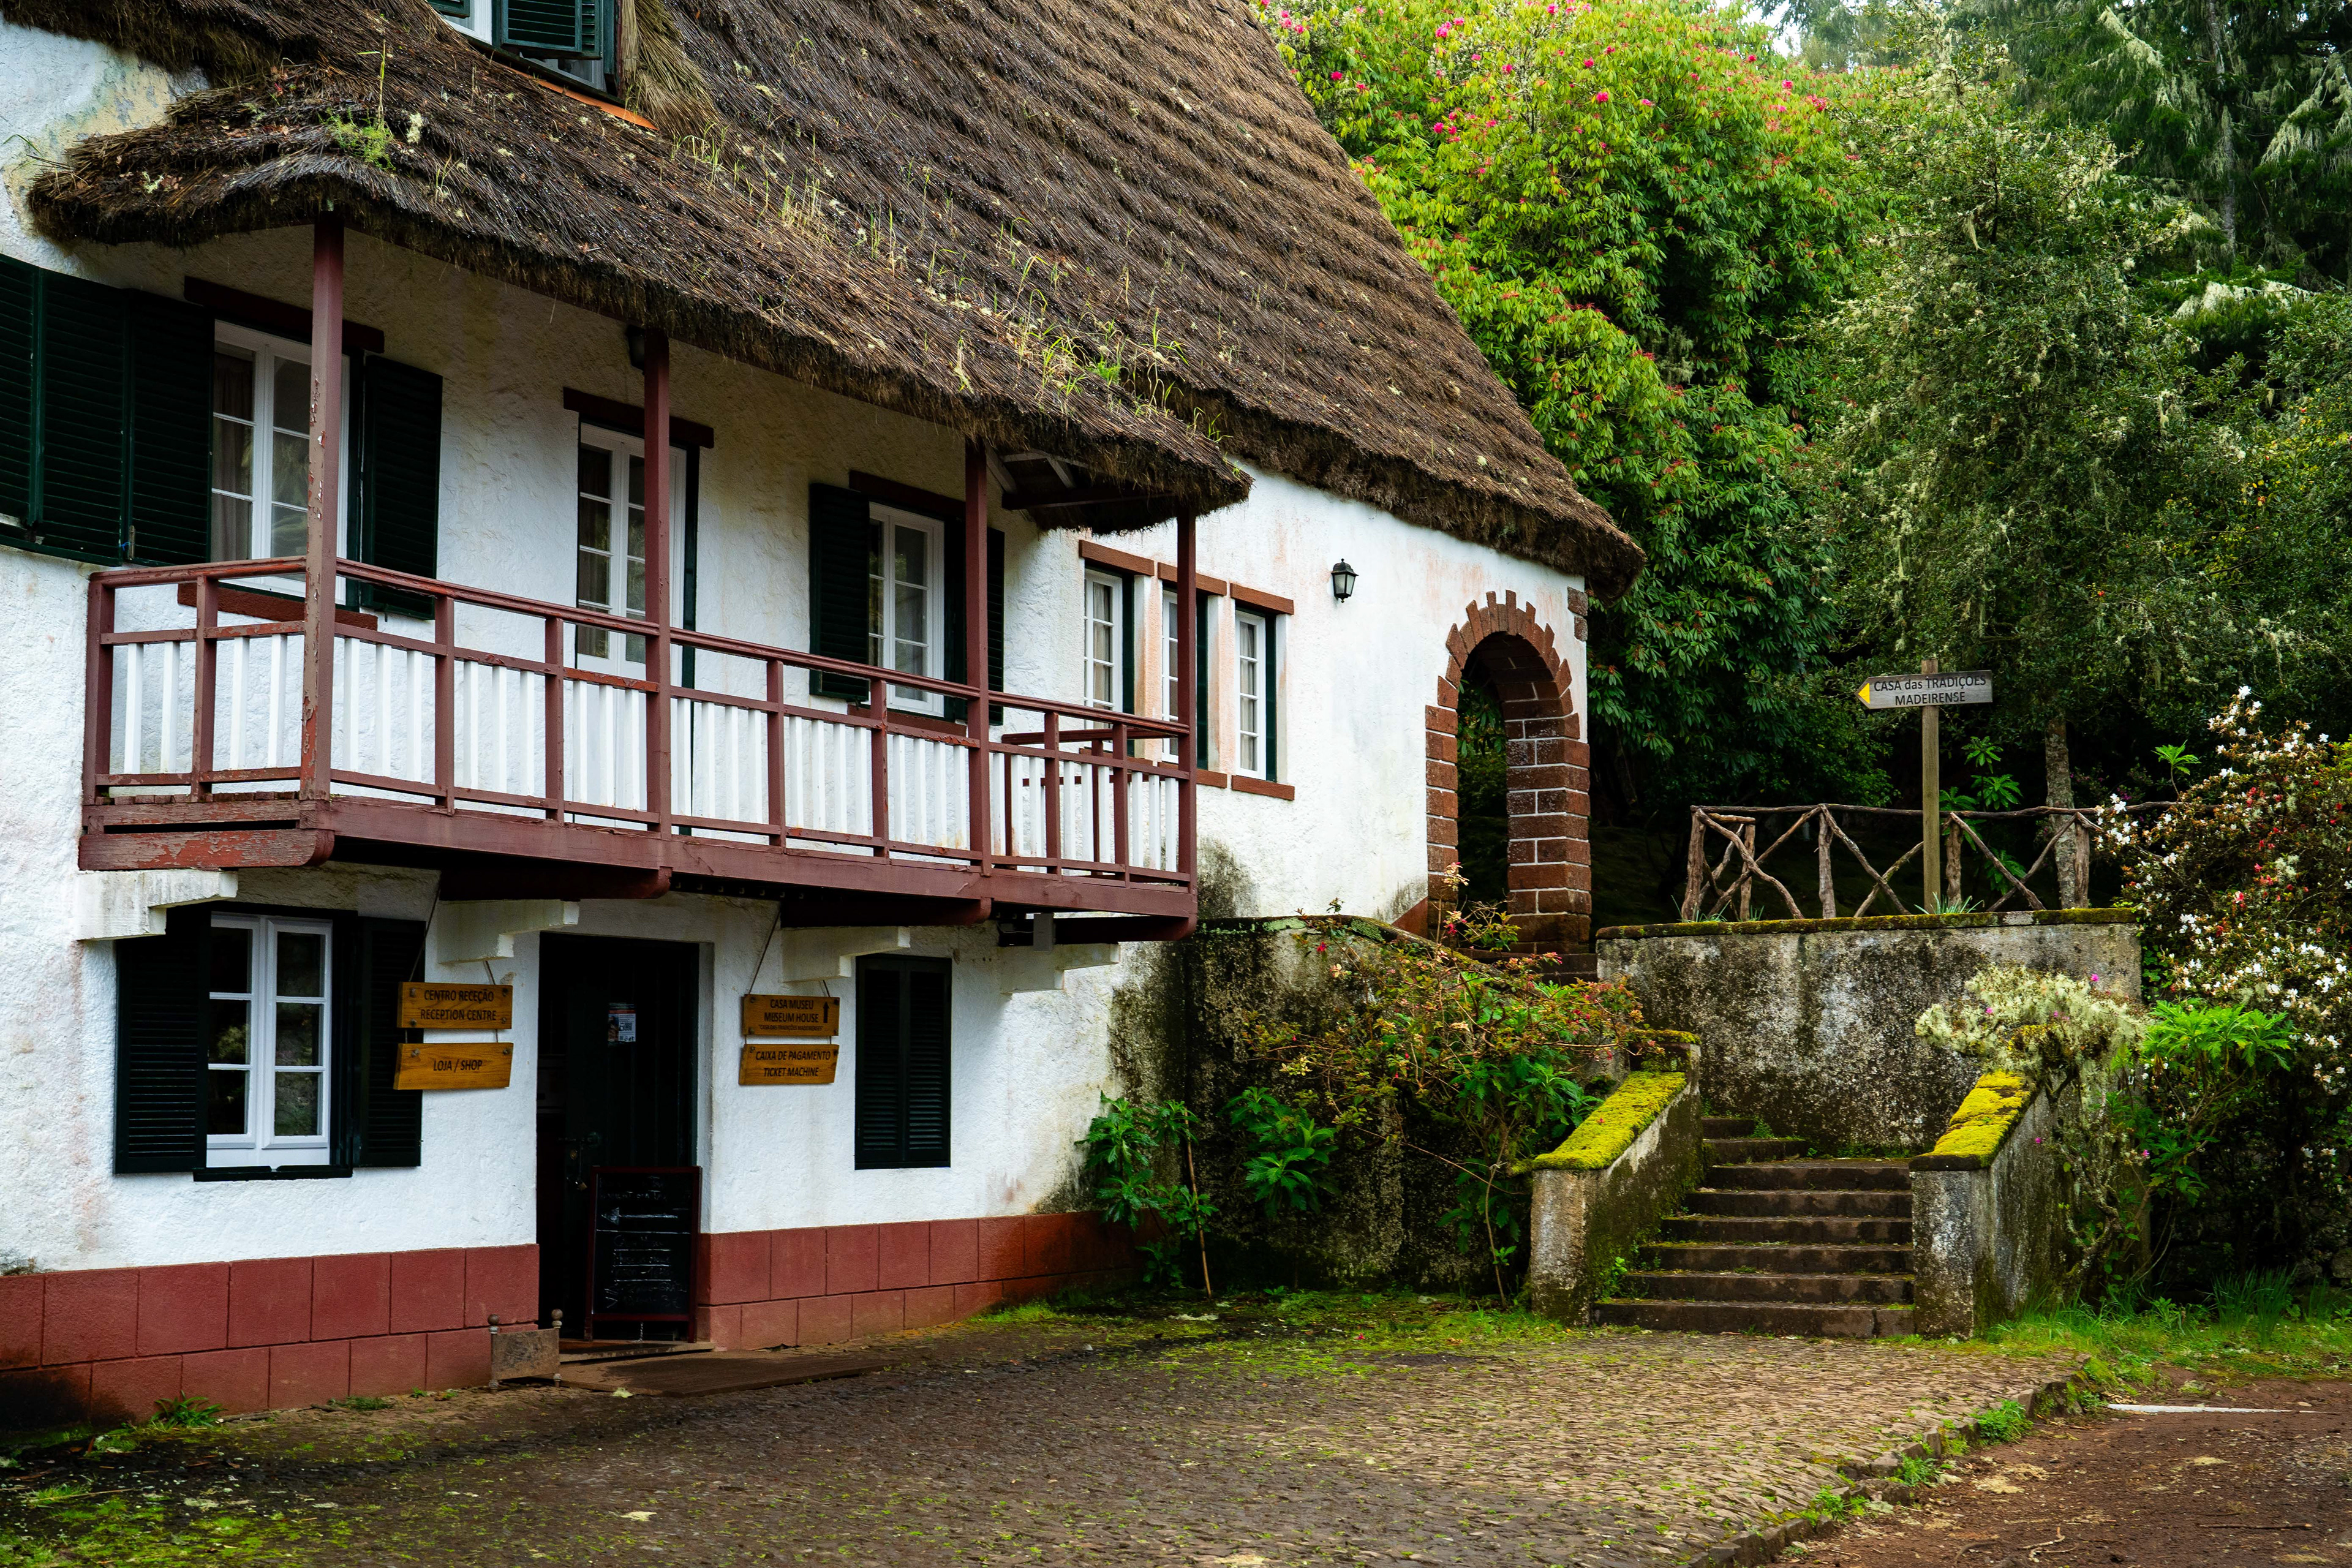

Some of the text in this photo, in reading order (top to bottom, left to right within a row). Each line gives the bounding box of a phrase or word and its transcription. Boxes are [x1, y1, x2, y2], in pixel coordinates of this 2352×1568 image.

[1874, 680, 1902, 692] CASA
[1905, 679, 1922, 690] das
[1895, 692, 1966, 706] MADEIRENSE
[424, 988, 494, 1003] CENTRO RECEÇÃO
[770, 999, 814, 1009] CASA MUSEU
[421, 1009, 497, 1020] RECEPTION CENTRE
[764, 1012, 819, 1023] MUSEUM HOUSE
[756, 1050, 831, 1060] CAIXA DE PAGAMENTO
[433, 1060, 452, 1071] LOJA
[461, 1060, 483, 1071] SHOP
[764, 1067, 819, 1077] TICKET MACHINE
